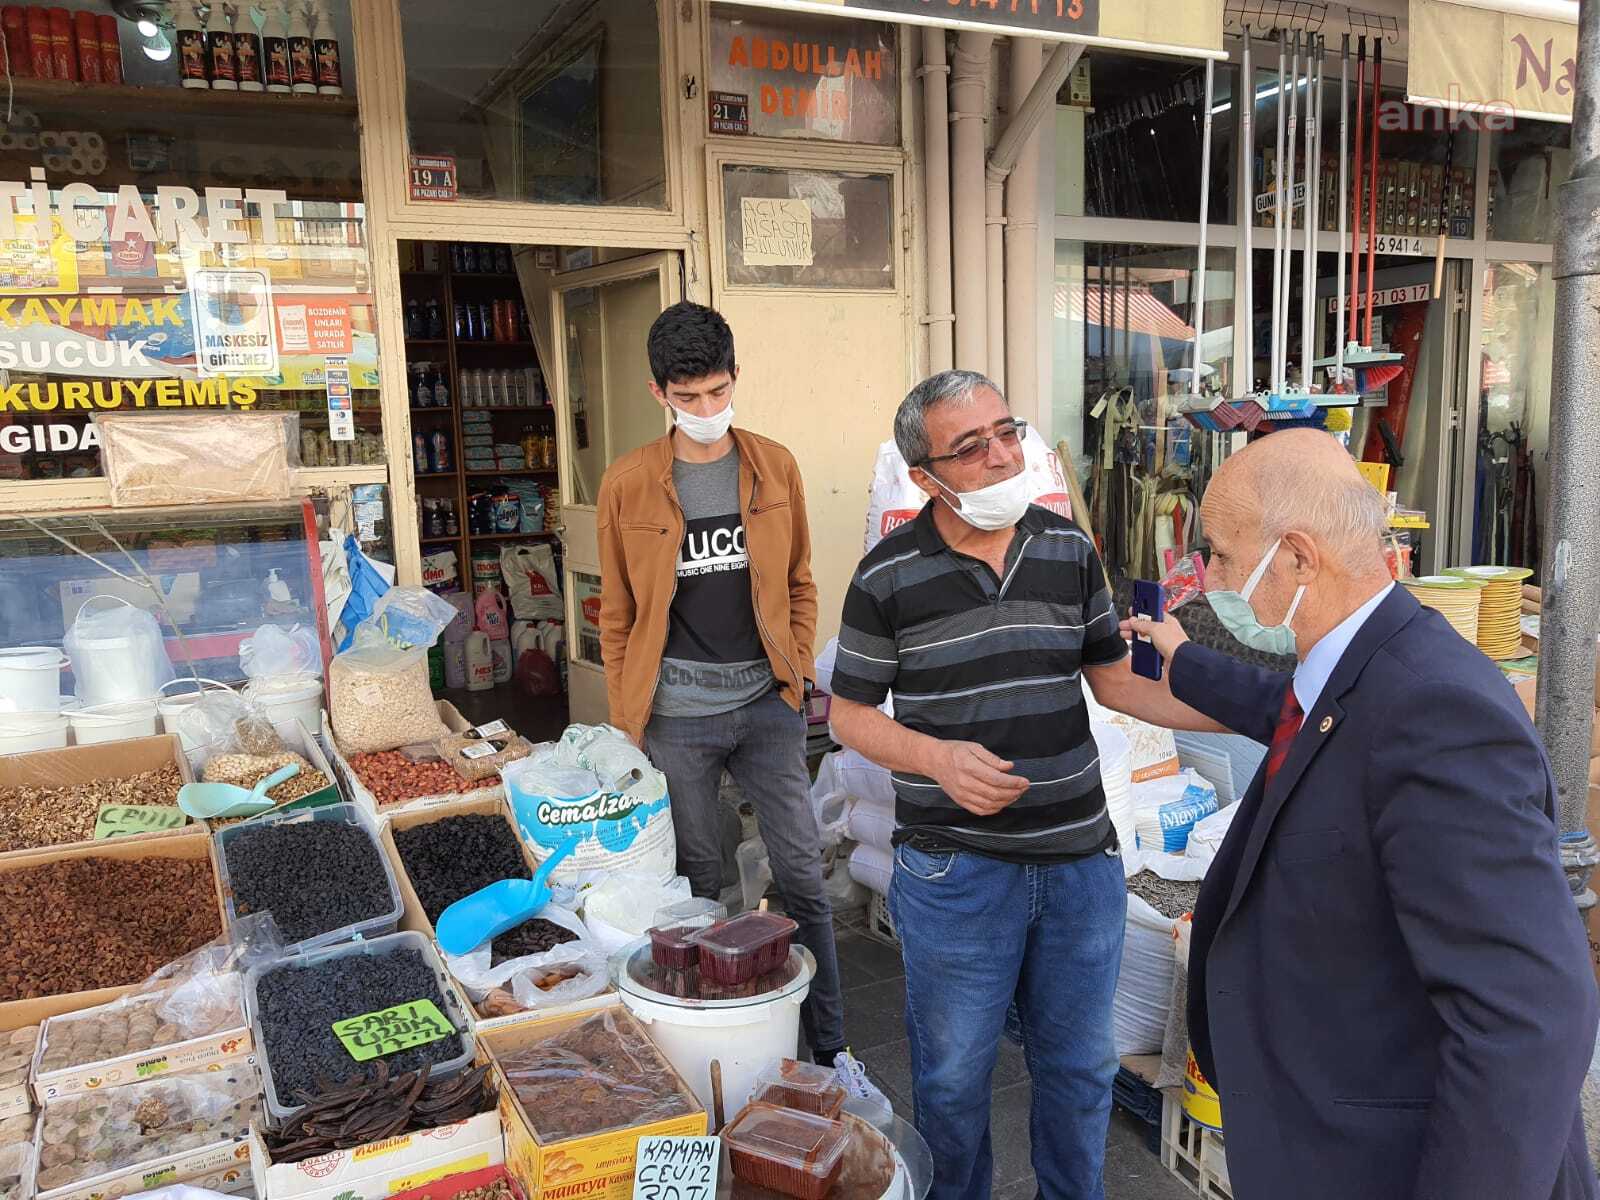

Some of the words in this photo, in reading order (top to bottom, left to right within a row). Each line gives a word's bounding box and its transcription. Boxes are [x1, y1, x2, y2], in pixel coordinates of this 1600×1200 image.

[729, 36, 881, 80] ABDULLAH
[713, 104, 728, 120] 21
[740, 106, 746, 121] A
[413, 170, 431, 186] 19
[444, 171, 453, 187] A
[1389, 237, 1408, 252] 941
[1391, 289, 1406, 303] 03
[1413, 285, 1427, 300] 17
[206, 332, 268, 348] MASKESİZ
[209, 352, 267, 367] GİRİLMEZ
[0, 373, 257, 412] KURUYEMİŞ
[714, 562, 730, 572] NINE
[643, 1139, 715, 1163] KAMAN
